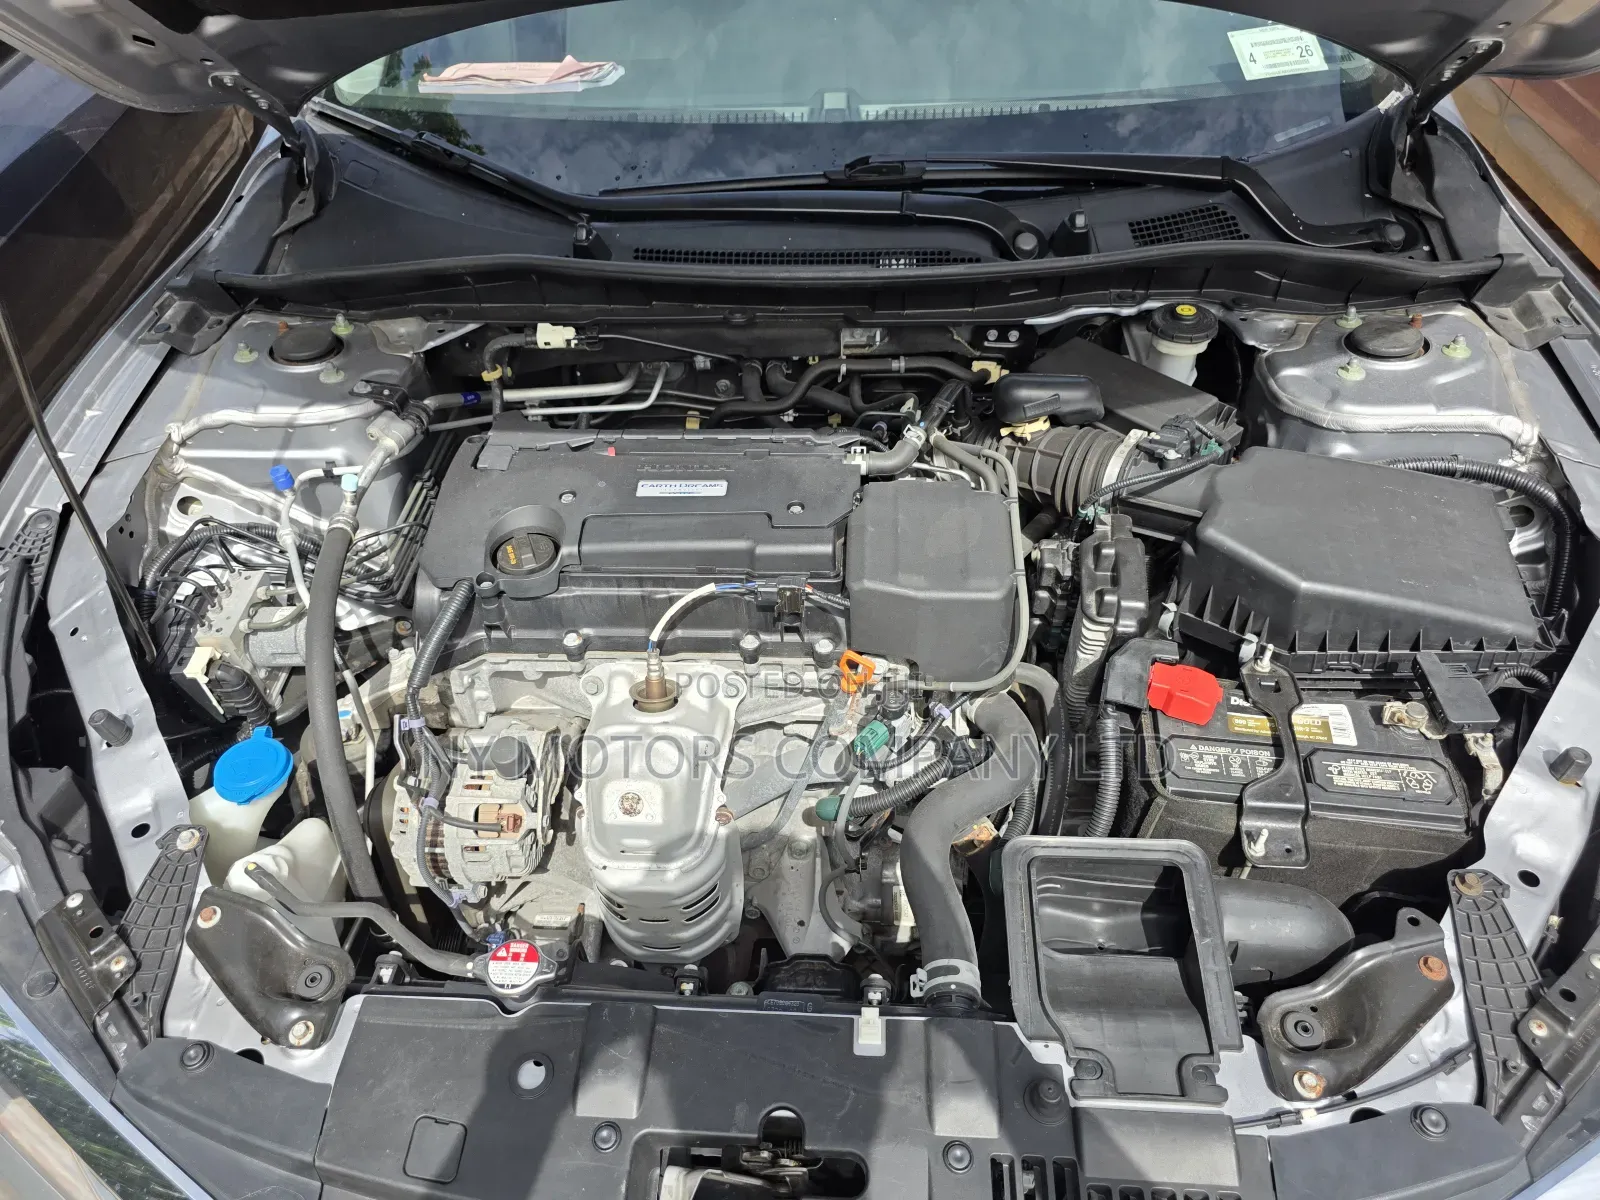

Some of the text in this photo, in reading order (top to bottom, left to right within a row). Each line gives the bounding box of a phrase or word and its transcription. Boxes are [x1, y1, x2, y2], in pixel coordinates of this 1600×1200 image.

[1296, 44, 1314, 58] 26
[1248, 52, 1257, 65] 4
[1198, 744, 1232, 754] DANGER
[1240, 748, 1271, 757] POISON
